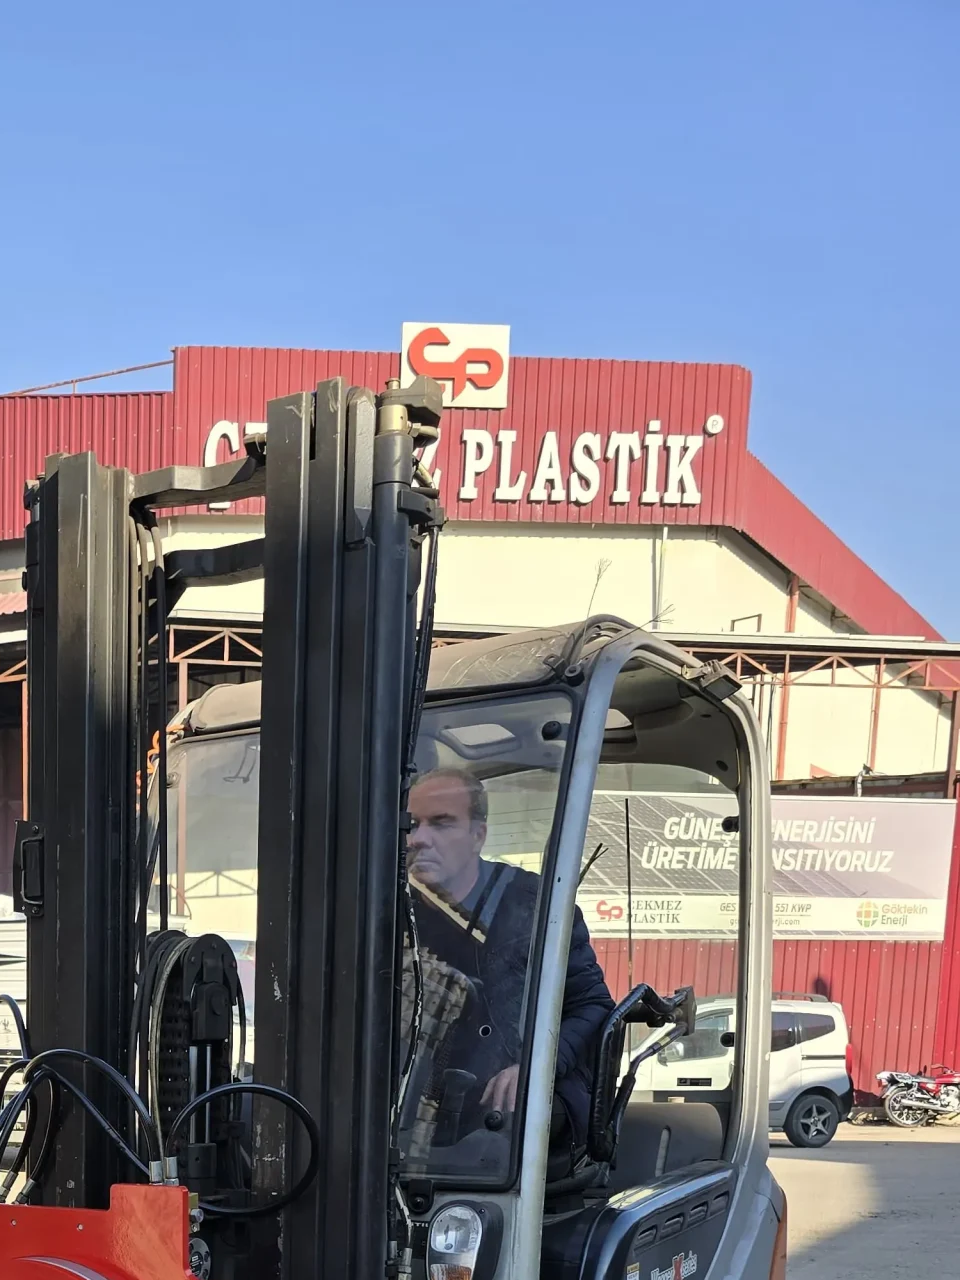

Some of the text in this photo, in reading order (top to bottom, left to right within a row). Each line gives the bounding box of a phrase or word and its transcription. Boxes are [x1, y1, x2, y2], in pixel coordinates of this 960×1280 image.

[459, 420, 704, 504] PLASTİK
[771, 816, 876, 843] NERJİSİNİ
[641, 841, 894, 872] ÜRETİME NSITIYORUZ
[630, 900, 682, 911] EKMEZ
[720, 903, 812, 913] GES 551 KWP
[881, 904, 928, 915] Göktekin
[881, 915, 908, 926] Enerji
